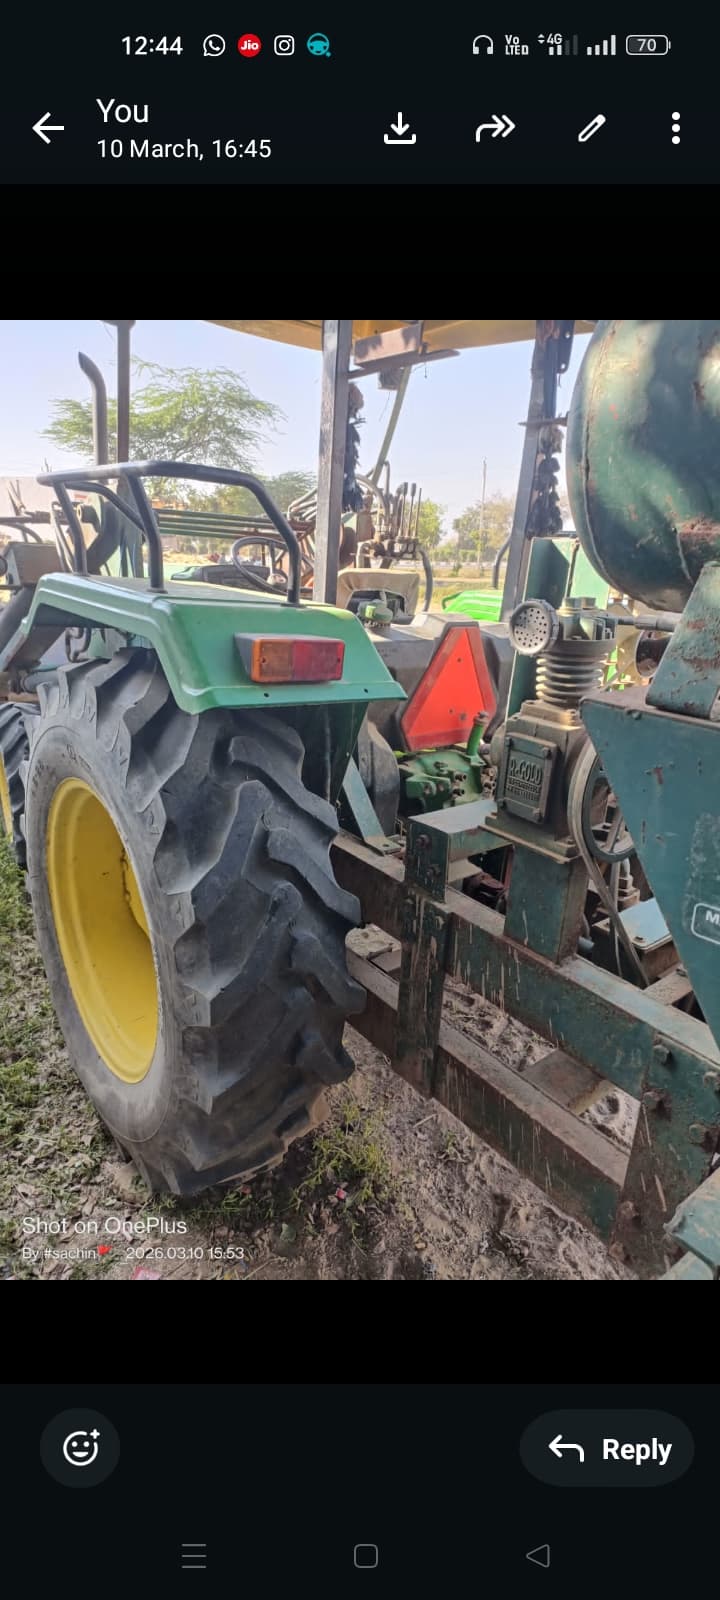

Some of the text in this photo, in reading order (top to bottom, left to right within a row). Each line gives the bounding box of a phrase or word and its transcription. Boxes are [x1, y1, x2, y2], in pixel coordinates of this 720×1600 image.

[122, 36, 183, 55] 12:44
[241, 40, 258, 50] Jio
[547, 34, 562, 44] 4G
[638, 39, 656, 51] 70
[96, 99, 148, 123] You
[98, 139, 271, 160] 10 March, 16:45
[603, 1438, 672, 1465] Reply
